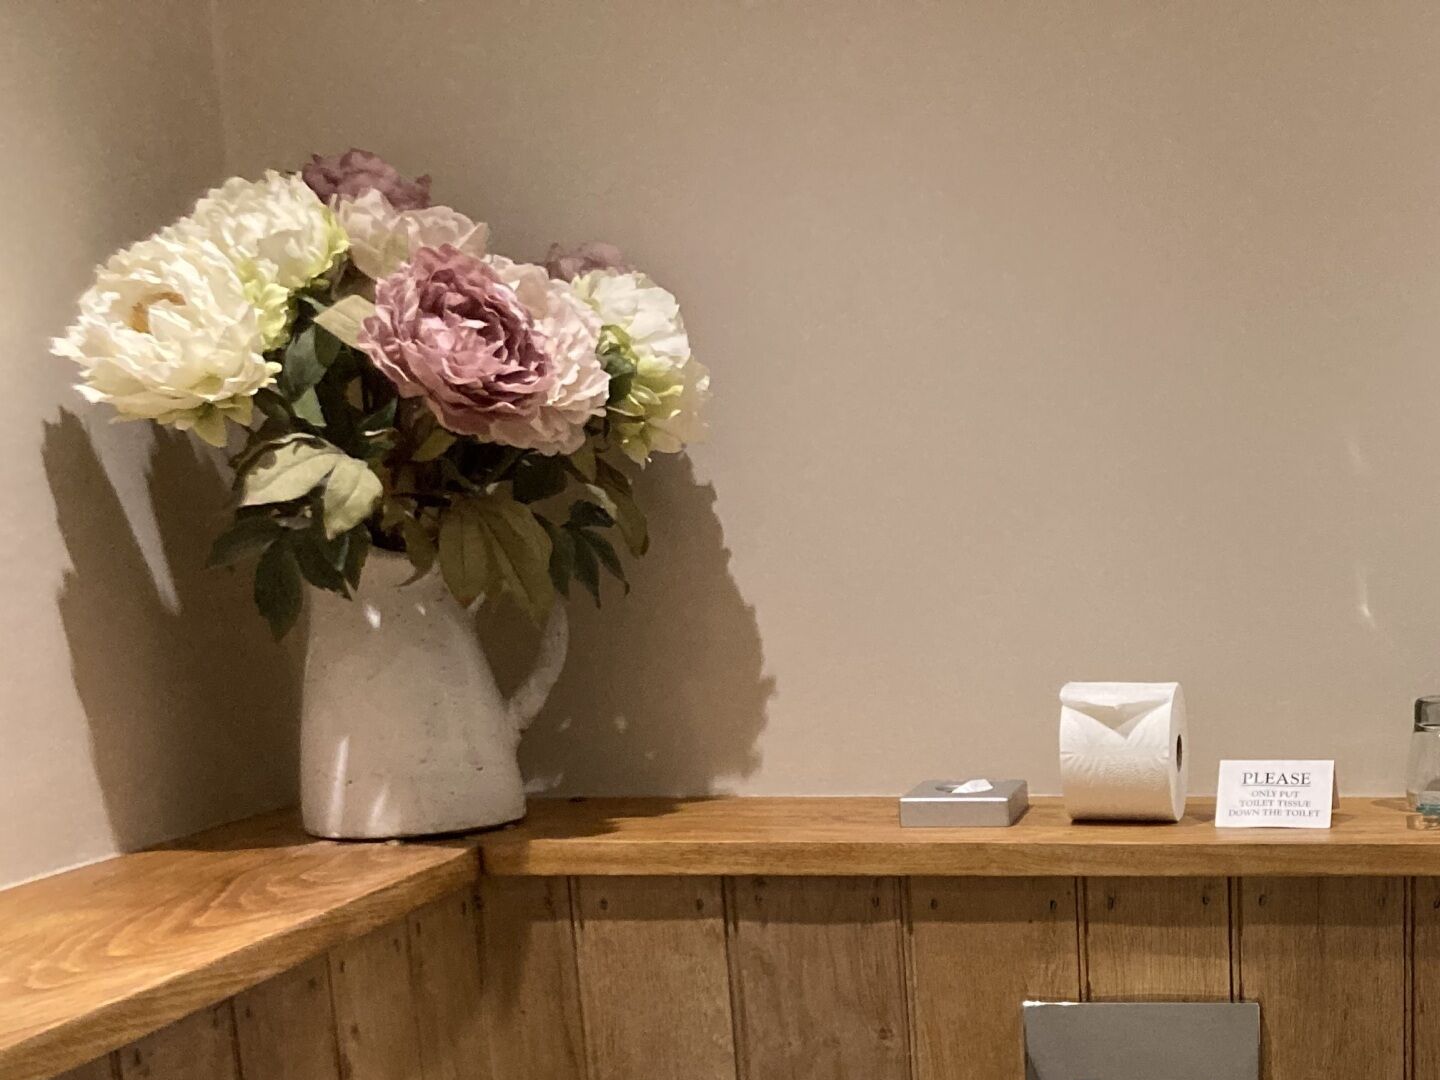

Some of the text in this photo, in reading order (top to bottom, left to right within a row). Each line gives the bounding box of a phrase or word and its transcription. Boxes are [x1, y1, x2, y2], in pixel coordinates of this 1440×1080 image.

[1243, 772, 1311, 785] PLEASE
[1252, 790, 1277, 798] ONLY
[1240, 799, 1311, 808] TOILET TISSUE
[1228, 809, 1260, 817] DOWN
[1285, 809, 1321, 817] TOILET
